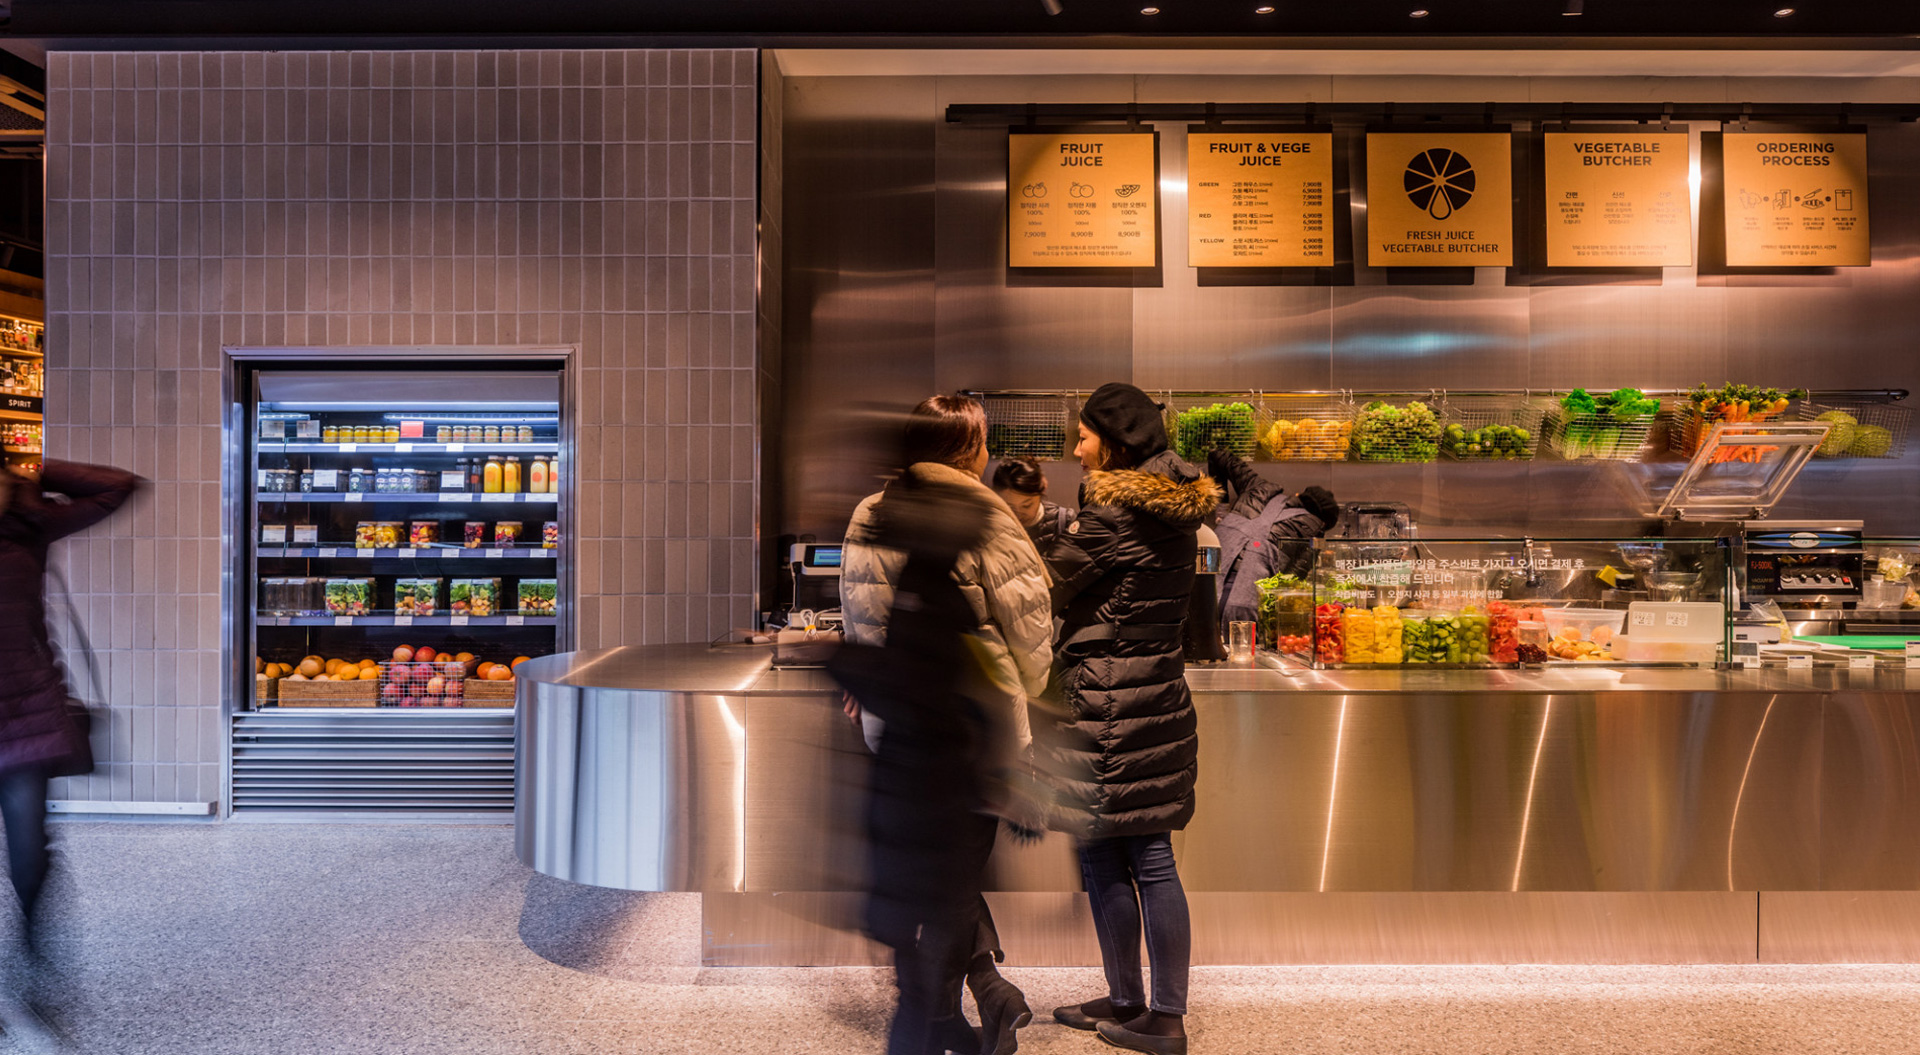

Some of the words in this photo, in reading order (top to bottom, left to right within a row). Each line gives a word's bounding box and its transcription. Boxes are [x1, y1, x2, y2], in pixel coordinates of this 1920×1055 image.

[1060, 143, 1104, 154] FRUIT
[1210, 144, 1252, 154] FRUIT
[1256, 144, 1266, 154] &
[1271, 144, 1310, 154] VEGE
[1574, 143, 1660, 153] VEGETABLE
[1756, 143, 1834, 153] ORDERING
[1060, 156, 1104, 167] JUICE
[1238, 156, 1282, 166] JUICE
[1583, 156, 1652, 166] BUTCHER
[1762, 156, 1830, 166] PROCESS
[1406, 231, 1440, 240] FRESH
[1444, 231, 1474, 240] JUICE
[1382, 244, 1444, 252] VEGETABLE
[1448, 244, 1498, 252] BUTCHER
[8, 399, 32, 408] SPIRIT
[1335, 558, 1356, 570] 매장
[1360, 558, 1369, 570] 내
[1406, 558, 1436, 570] 과일을
[1440, 558, 1481, 570] 주스바로
[1484, 558, 1514, 570] 가지고
[1518, 558, 1548, 570] 오시면
[1551, 558, 1572, 570] 결제
[1574, 558, 1585, 570] 후
[1414, 574, 1454, 585] 드립니다
[1387, 590, 1412, 600] 오렌지
[1414, 590, 1430, 600] 사과
[1432, 590, 1440, 600] 등
[1442, 590, 1459, 600] 일부
[1460, 590, 1484, 600] 과일에
[1486, 590, 1503, 600] 한함
